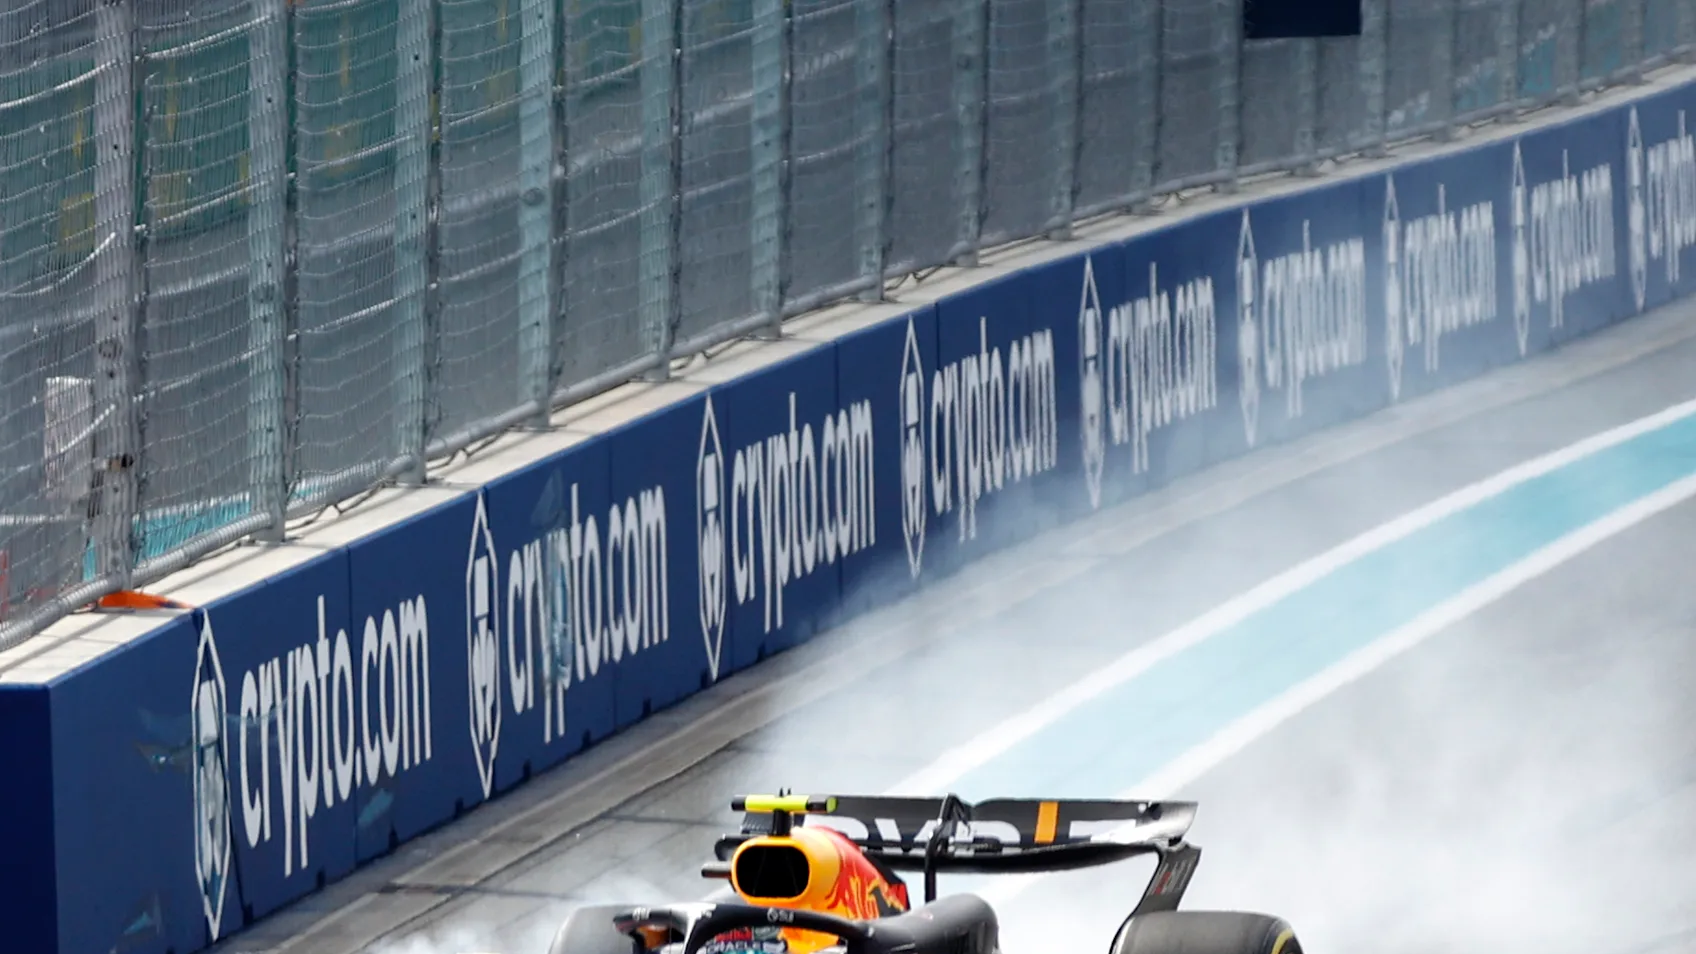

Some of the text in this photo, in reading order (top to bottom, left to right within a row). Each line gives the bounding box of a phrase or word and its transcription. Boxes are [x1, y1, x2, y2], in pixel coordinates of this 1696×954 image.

[930, 316, 1057, 543] crypto.com
[1108, 262, 1217, 475] crypto.com
[507, 483, 669, 744] crypto.com
[731, 392, 876, 633] crypto.com
[239, 594, 432, 878] crypto.com
